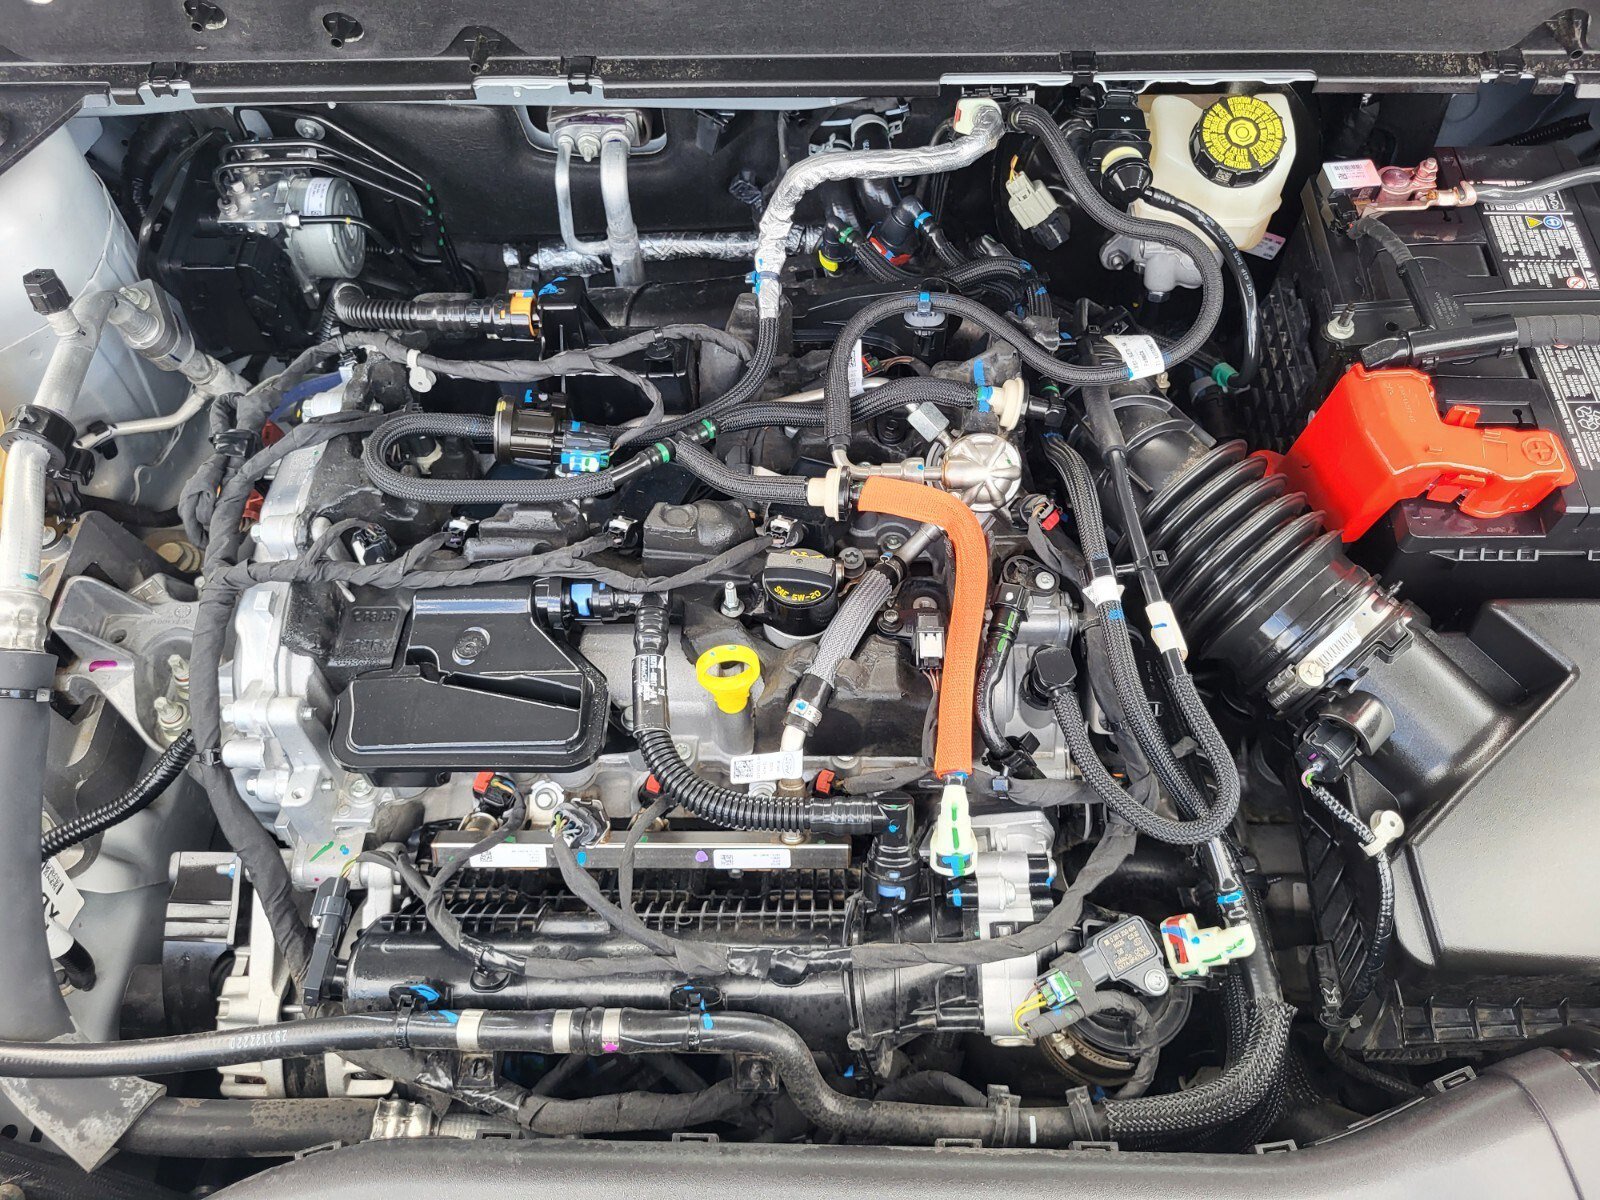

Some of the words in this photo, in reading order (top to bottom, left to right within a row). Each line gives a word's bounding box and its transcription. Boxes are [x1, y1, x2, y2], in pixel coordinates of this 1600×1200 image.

[1227, 96, 1251, 104] ATTENTION
[1208, 147, 1223, 163] SEALED
[1223, 159, 1250, 168] CONTAINER
[774, 586, 790, 598] SAE
[792, 590, 822, 602] 5W-20
